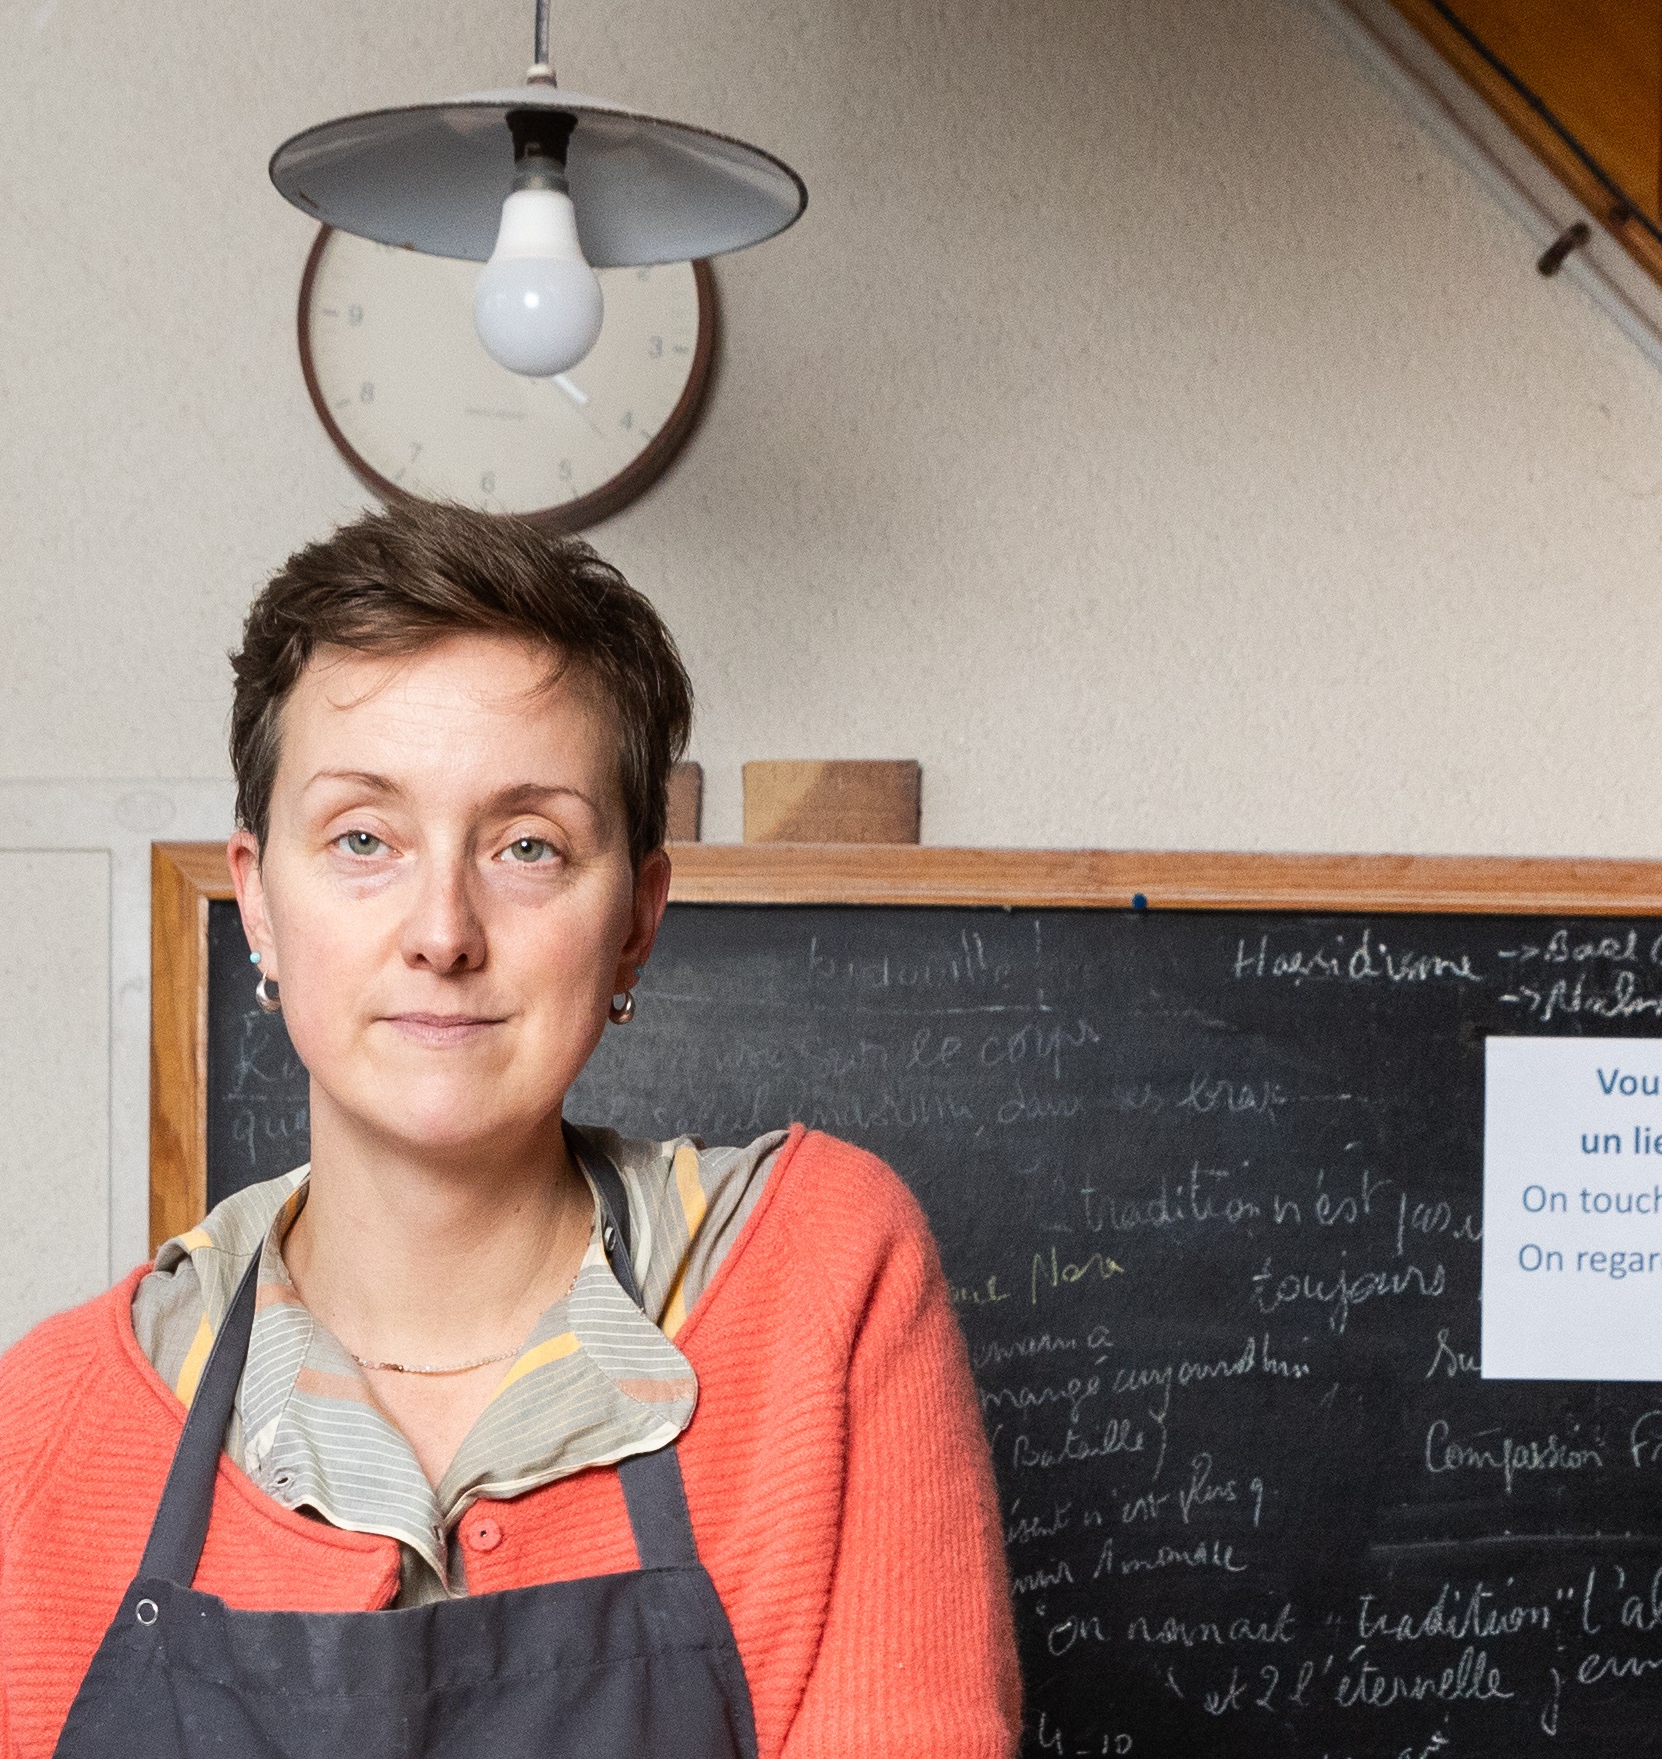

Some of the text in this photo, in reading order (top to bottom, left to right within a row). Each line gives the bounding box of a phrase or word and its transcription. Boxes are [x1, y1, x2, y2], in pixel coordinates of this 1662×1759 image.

[347, 304, 365, 326] 9
[648, 335, 664, 359] 3
[358, 381, 376, 403] 8
[618, 408, 634, 431] 4
[1580, 1132, 1622, 1156] un
[1522, 1183, 1567, 1214] On
[1518, 1242, 1564, 1273] On
[1250, 1255, 1446, 1335] toujours
